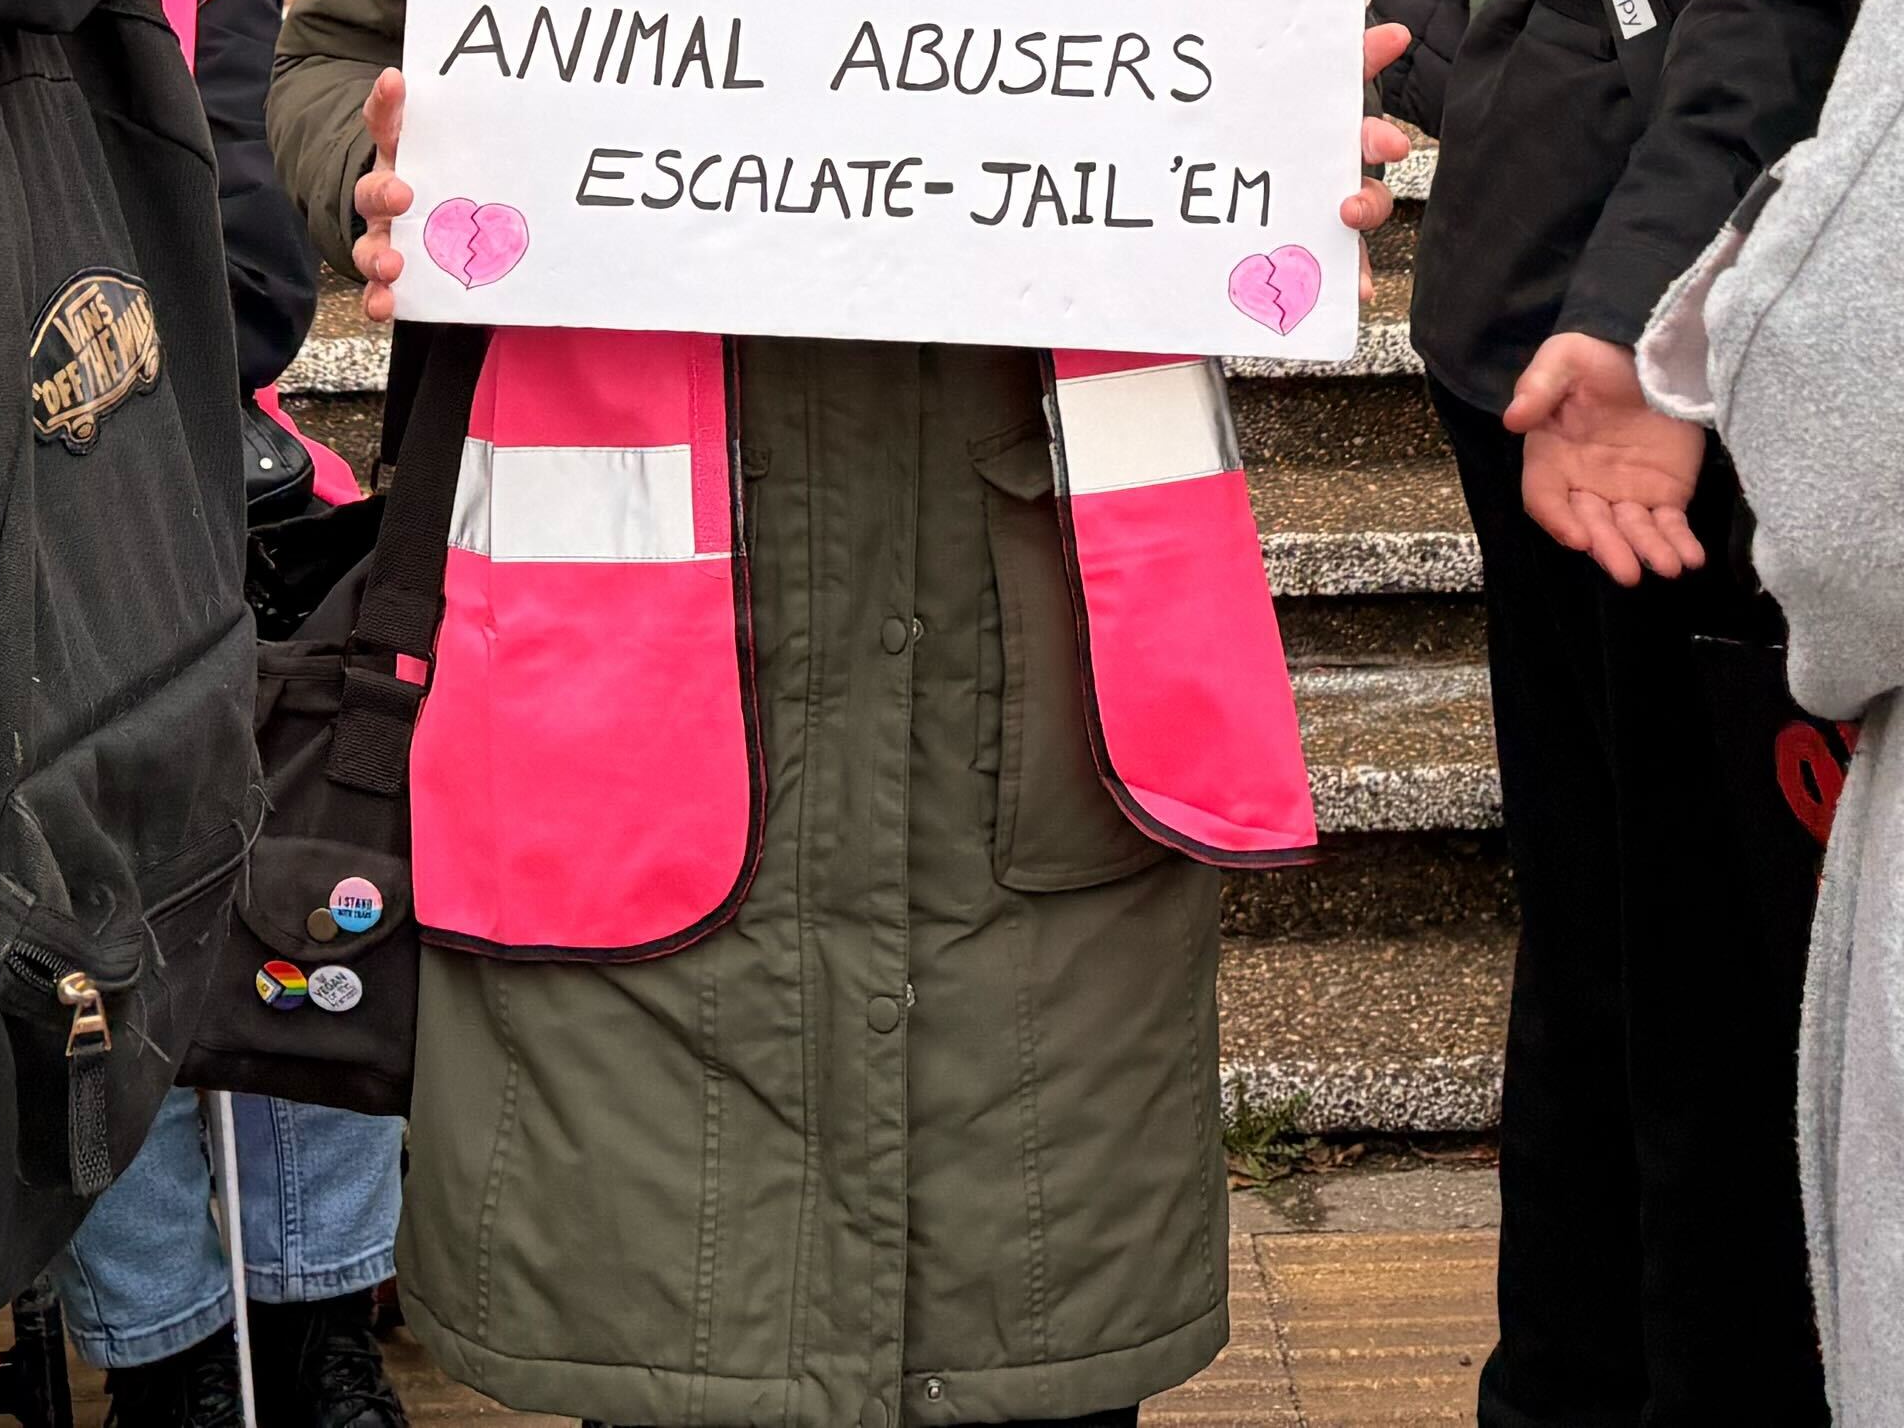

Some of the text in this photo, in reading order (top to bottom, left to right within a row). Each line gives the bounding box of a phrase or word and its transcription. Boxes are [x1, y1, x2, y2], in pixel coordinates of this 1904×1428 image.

[439, 4, 1214, 102] ANIMAL ABUSERS
[53, 282, 116, 354] VANS
[78, 328, 125, 399] THE
